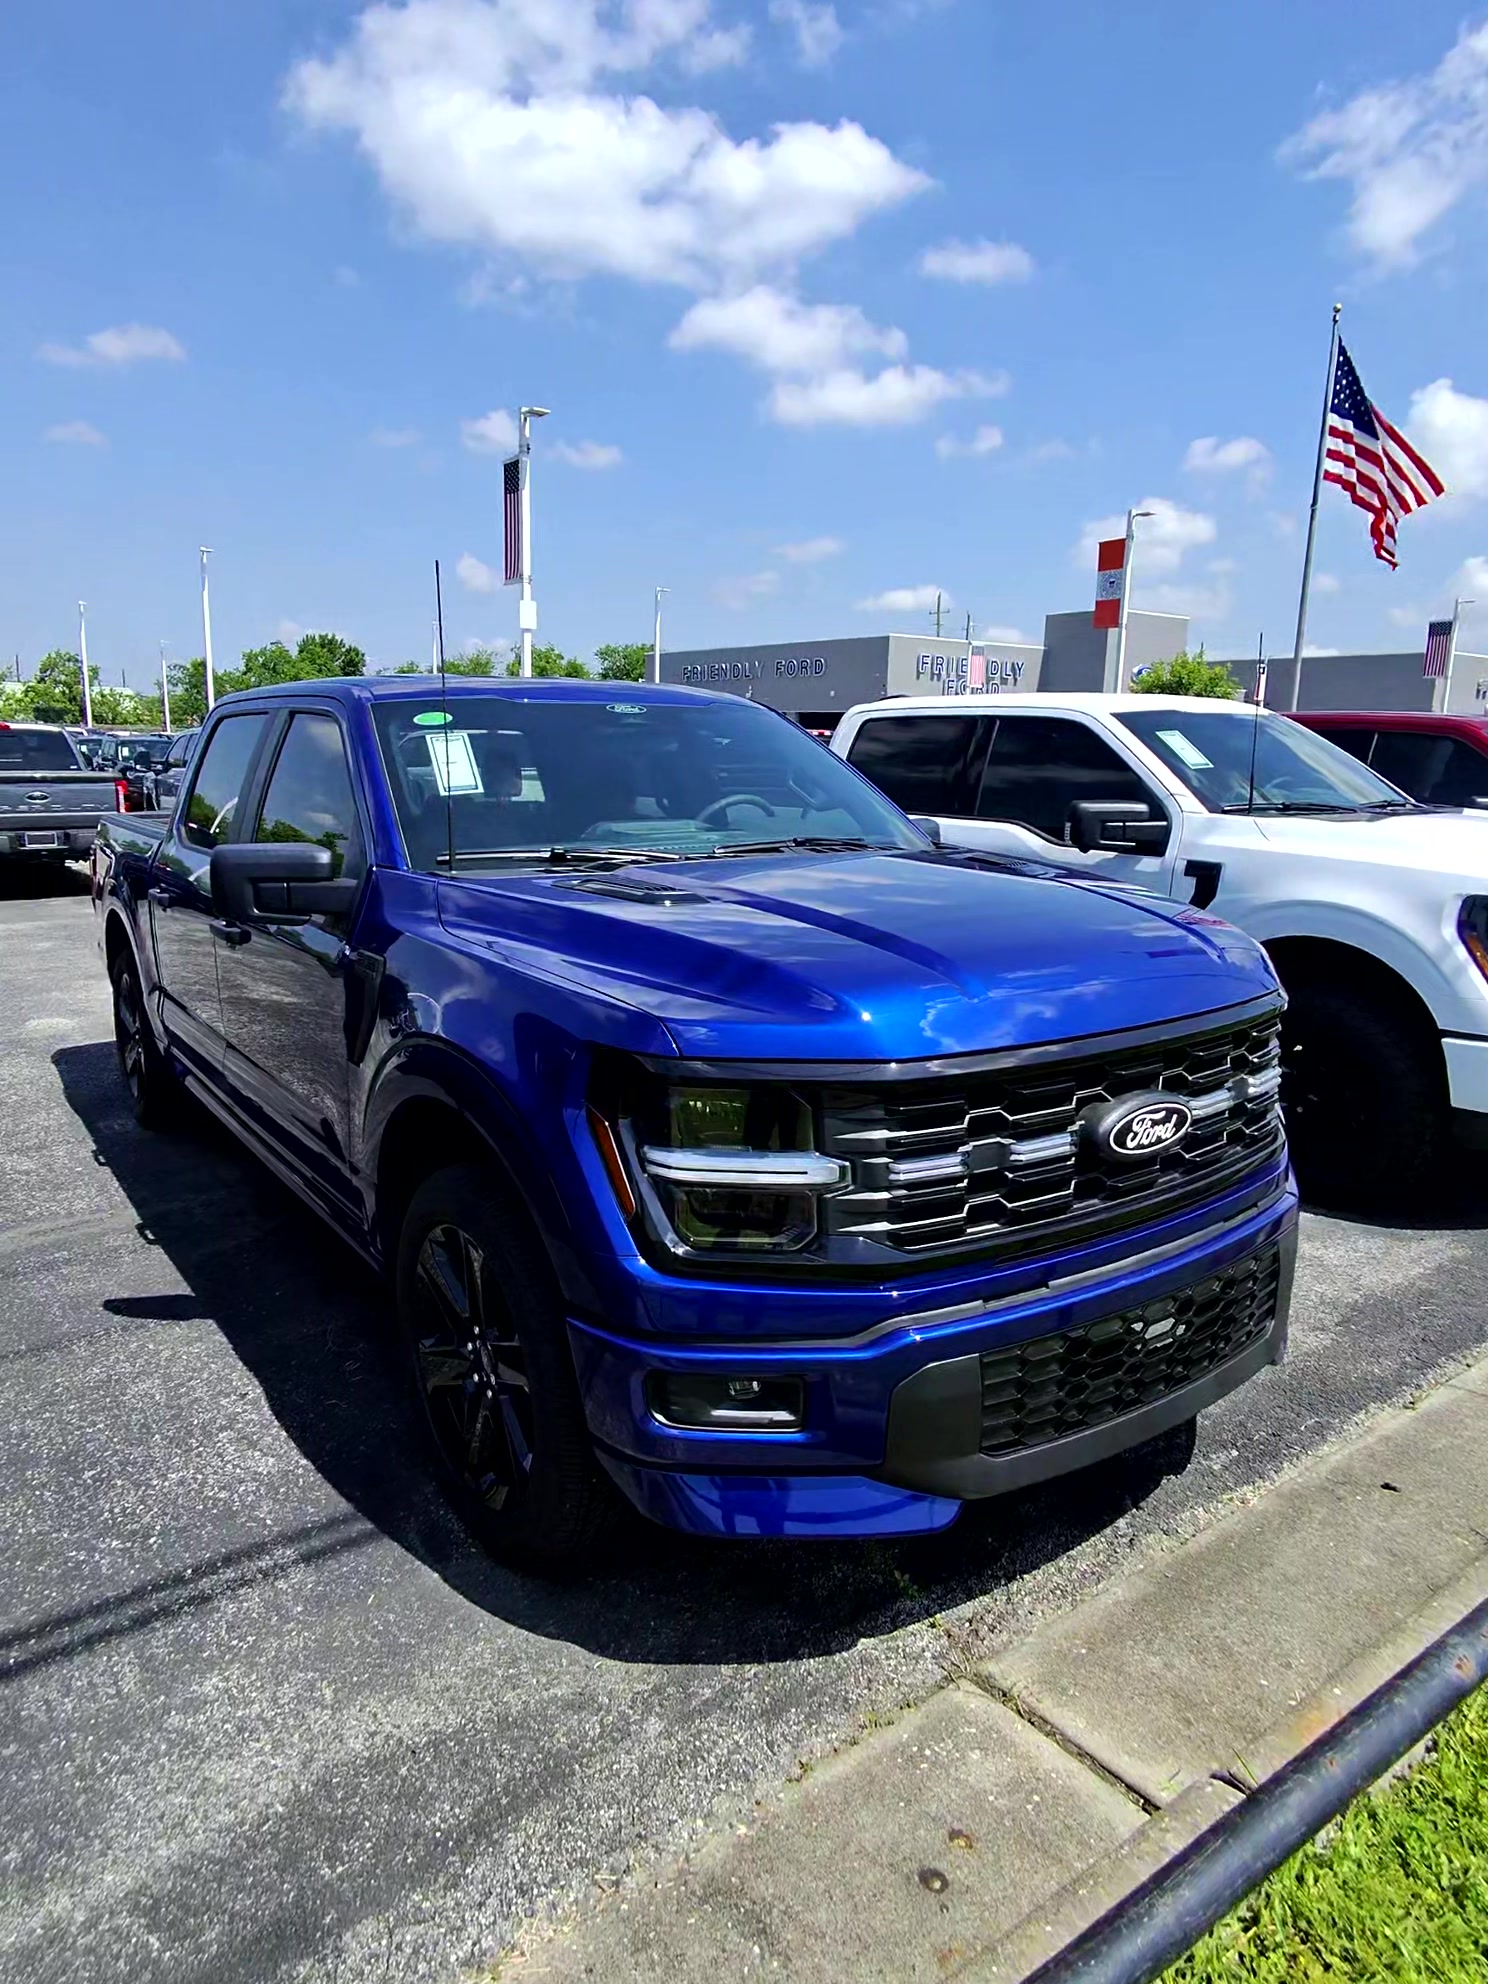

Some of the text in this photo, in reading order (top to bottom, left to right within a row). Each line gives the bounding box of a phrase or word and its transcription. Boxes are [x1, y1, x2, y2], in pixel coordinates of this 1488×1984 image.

[682, 658, 825, 681] FRIENDLY FORD
[919, 654, 1025, 679] FRIEDLY
[1126, 1110, 1178, 1149] Ford
